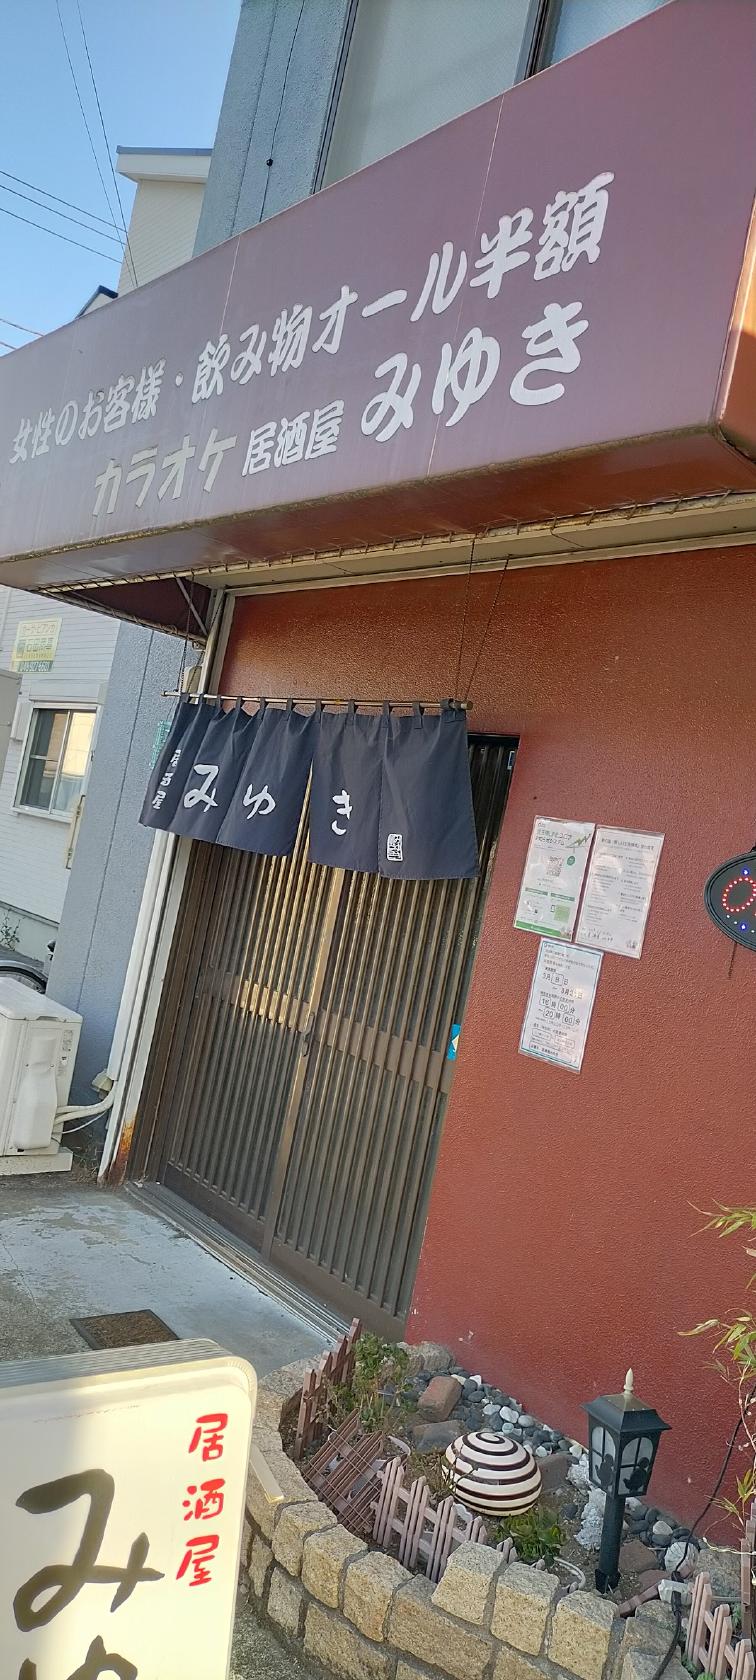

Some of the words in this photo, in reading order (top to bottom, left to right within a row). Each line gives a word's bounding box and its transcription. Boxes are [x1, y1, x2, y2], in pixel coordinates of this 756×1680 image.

[93, 429, 236, 516] カラオケ
[242, 400, 344, 476] 居酒屋
[361, 302, 589, 442] みゆき
[176, 1413, 228, 1587] 居酒屋
